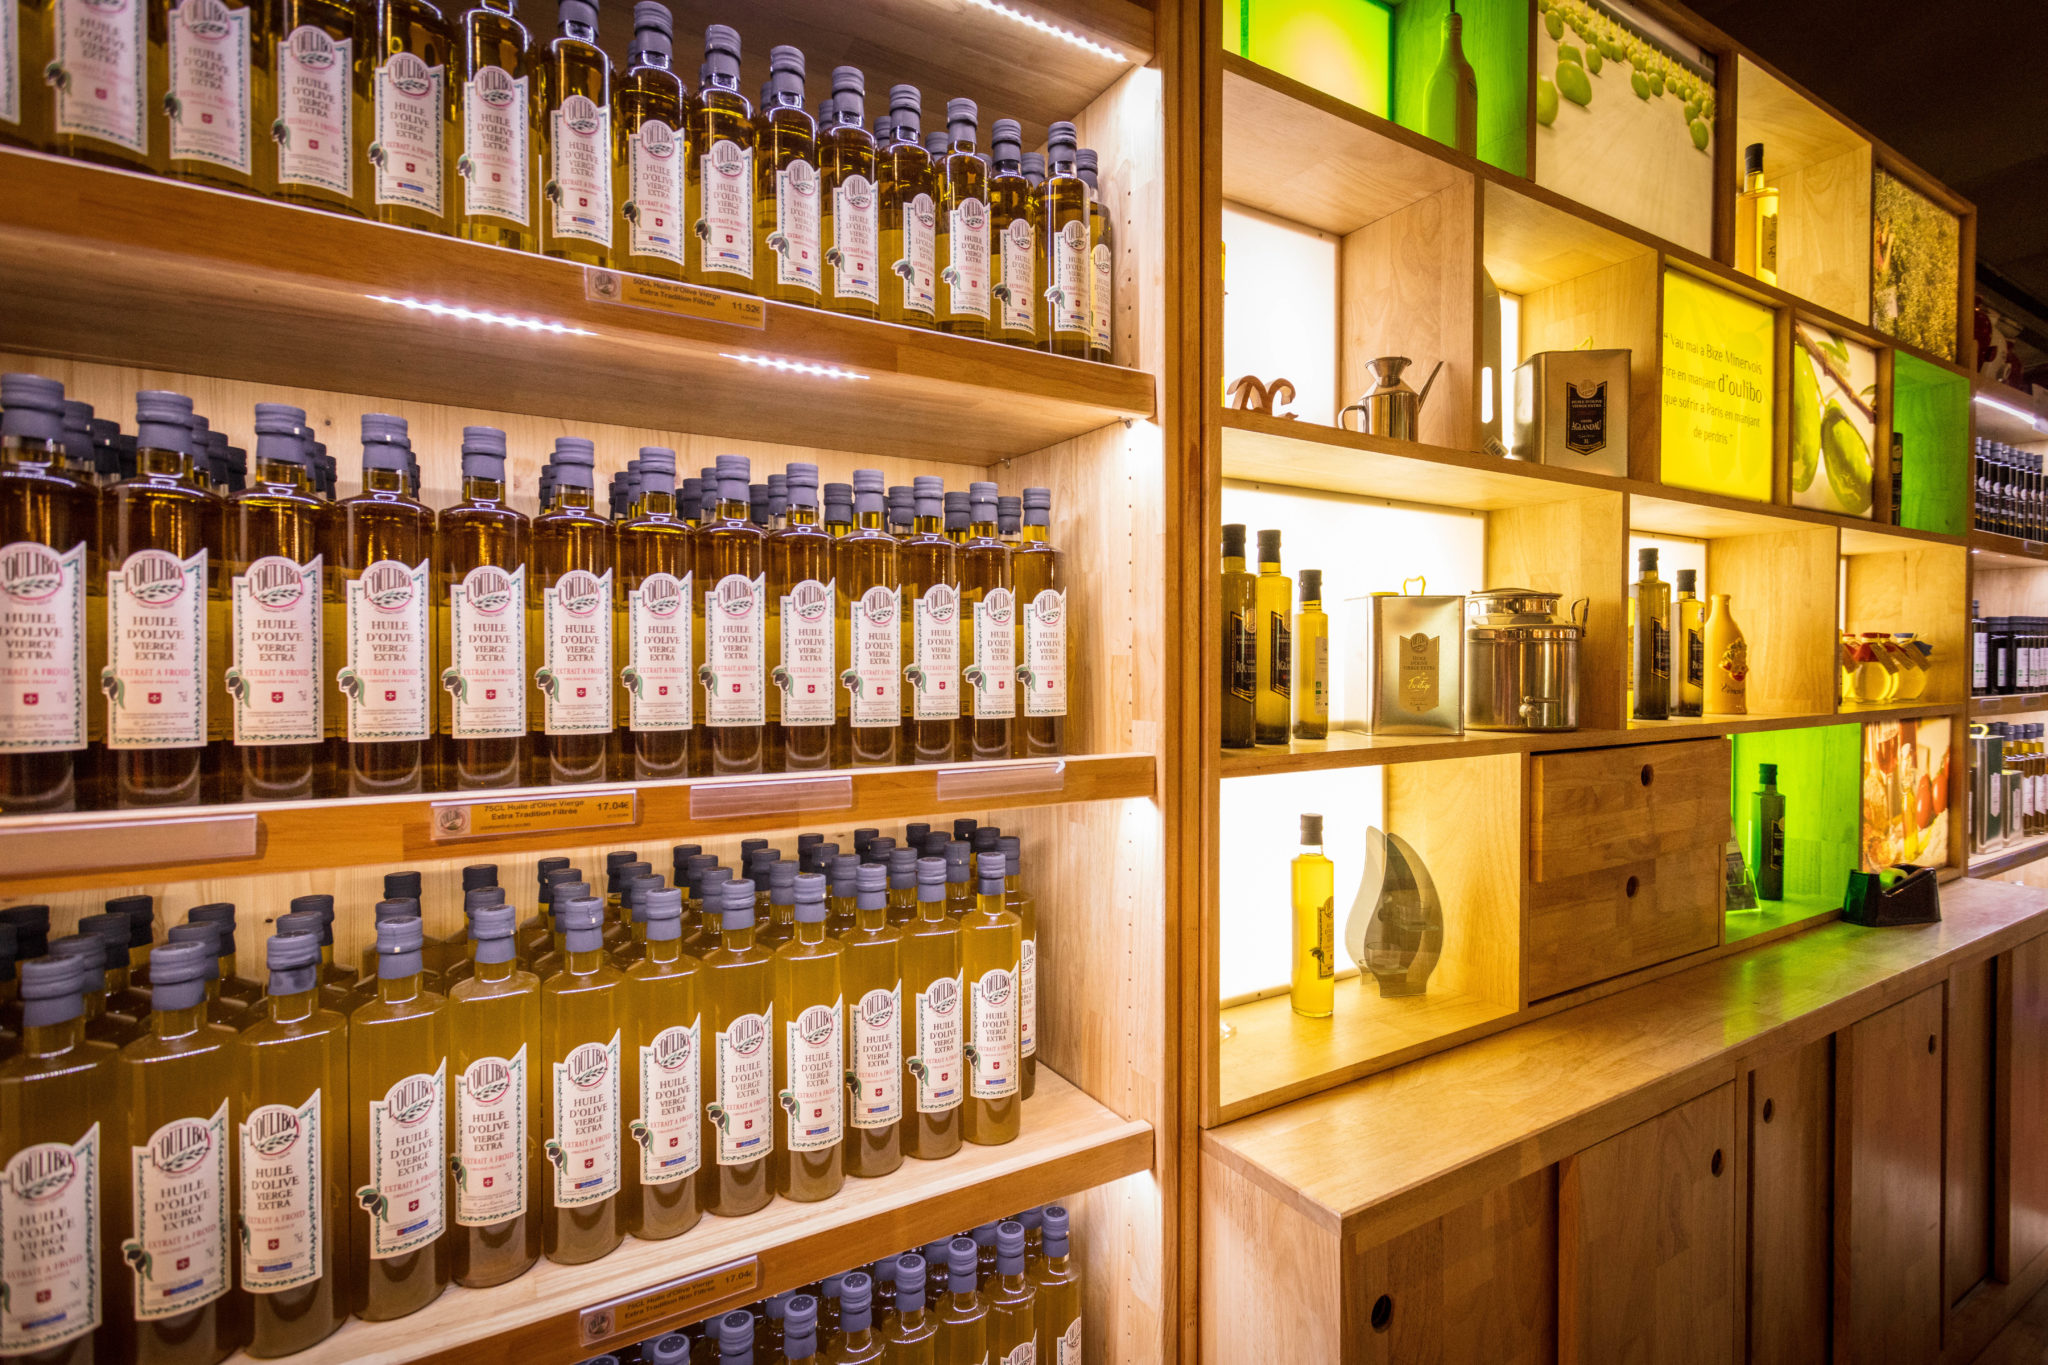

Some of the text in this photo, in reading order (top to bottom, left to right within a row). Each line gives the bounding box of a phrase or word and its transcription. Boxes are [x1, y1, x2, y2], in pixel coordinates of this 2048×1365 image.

[296, 76, 329, 91] HUILE
[291, 86, 335, 104] D'OLIVE
[296, 97, 329, 111] VIERGE
[395, 102, 424, 116] HUILE
[299, 106, 329, 118] EXTRA
[391, 112, 429, 128] D'OLIVE
[481, 114, 509, 126] HUILE
[395, 122, 424, 135] VIERGE
[477, 124, 514, 138] D'OLIVE
[397, 130, 424, 142] EXTRA
[481, 133, 510, 145] VIERGE
[483, 141, 509, 152] EXTRA
[569, 142, 594, 153] HUILE
[566, 151, 599, 165] D'OLIVE
[569, 160, 594, 171] VIERGE
[571, 168, 594, 178] EXTRA
[640, 288, 658, 297] Extra
[659, 290, 692, 302] Tradition
[1670, 334, 1683, 349] Vau
[1707, 344, 1722, 362] Bize
[1726, 350, 1762, 375] Minervois
[1678, 371, 1686, 380] en
[1688, 374, 1716, 390] manjant
[1718, 374, 1762, 403] d'oulibo
[1664, 394, 1677, 406] que
[1679, 397, 1698, 409] sofrir
[1707, 402, 1723, 418] Paris
[1725, 411, 1733, 420] en
[1735, 412, 1760, 428] manjant
[1693, 426, 1702, 438] de
[1704, 430, 1728, 445] perdris
[133, 616, 177, 626] HUILE
[257, 620, 297, 629] HUILE
[372, 621, 408, 630] HUILE
[474, 624, 506, 632] HUILE
[565, 625, 596, 633] HUILE
[126, 629, 183, 640] D'OLIVE
[252, 632, 302, 642] D'OLIVE
[367, 633, 413, 643] D'OLIVE
[469, 635, 511, 644] D'OLIVE
[561, 636, 600, 644] D'OLIVE
[644, 636, 680, 644] D'OLIVE
[133, 642, 177, 650] VIERGE
[258, 644, 297, 652] VIERGE
[372, 644, 408, 652] VIERGE
[795, 638, 826, 646] D'OLIVE
[866, 642, 894, 650] D'OLIVE
[135, 652, 174, 660] EXTRA
[508, 803, 528, 811] Huile
[530, 801, 556, 810] d'Olive
[559, 800, 584, 808] Vierge
[598, 801, 629, 811] 17.04€
[492, 813, 513, 821] Extra
[516, 810, 550, 819] Tradition
[800, 1011, 832, 1038] L'OULIBO
[730, 1019, 763, 1048] L'OULIBO
[654, 1032, 689, 1063] L'OULIBO
[805, 1052, 830, 1062] HUILE
[568, 1049, 606, 1080] L'OULIBO
[736, 1061, 761, 1072] HUILE
[802, 1060, 833, 1072] D'OLIVE
[466, 1063, 507, 1095] L'OULIBO
[732, 1069, 764, 1083] D'OLIVE
[806, 1070, 830, 1079] VIERGE
[660, 1076, 687, 1089] HUILE
[736, 1079, 761, 1090] VIERGE
[807, 1078, 829, 1087] EXTRA
[656, 1085, 690, 1099] D'OLIVE
[737, 1088, 759, 1098] EXTRA
[389, 1081, 433, 1118] L'OULIBO
[574, 1094, 604, 1107] HUILE
[660, 1095, 687, 1107] VIERGE
[570, 1103, 608, 1118] D'OLIVE
[662, 1104, 685, 1116] EXTRA
[472, 1111, 504, 1122] HUILE
[574, 1114, 604, 1126] VIERGE
[250, 1110, 295, 1146] L'OULIBO
[468, 1121, 508, 1134] D'OLIVE
[576, 1123, 602, 1135] EXTRA
[396, 1129, 430, 1146] HUILE
[473, 1132, 504, 1143] VIERGE
[391, 1138, 434, 1159] D'OLIVE
[475, 1142, 502, 1152] EXTRA
[396, 1150, 430, 1167] VIERGE
[256, 1165, 293, 1178] HUILE
[398, 1161, 428, 1177] EXTRA
[252, 1177, 299, 1190] D'OLIVE
[256, 1189, 293, 1200] VIERGE
[258, 1199, 291, 1210] EXTRA
[625, 1309, 644, 1319] Extra
[646, 1300, 677, 1313] Tradition
